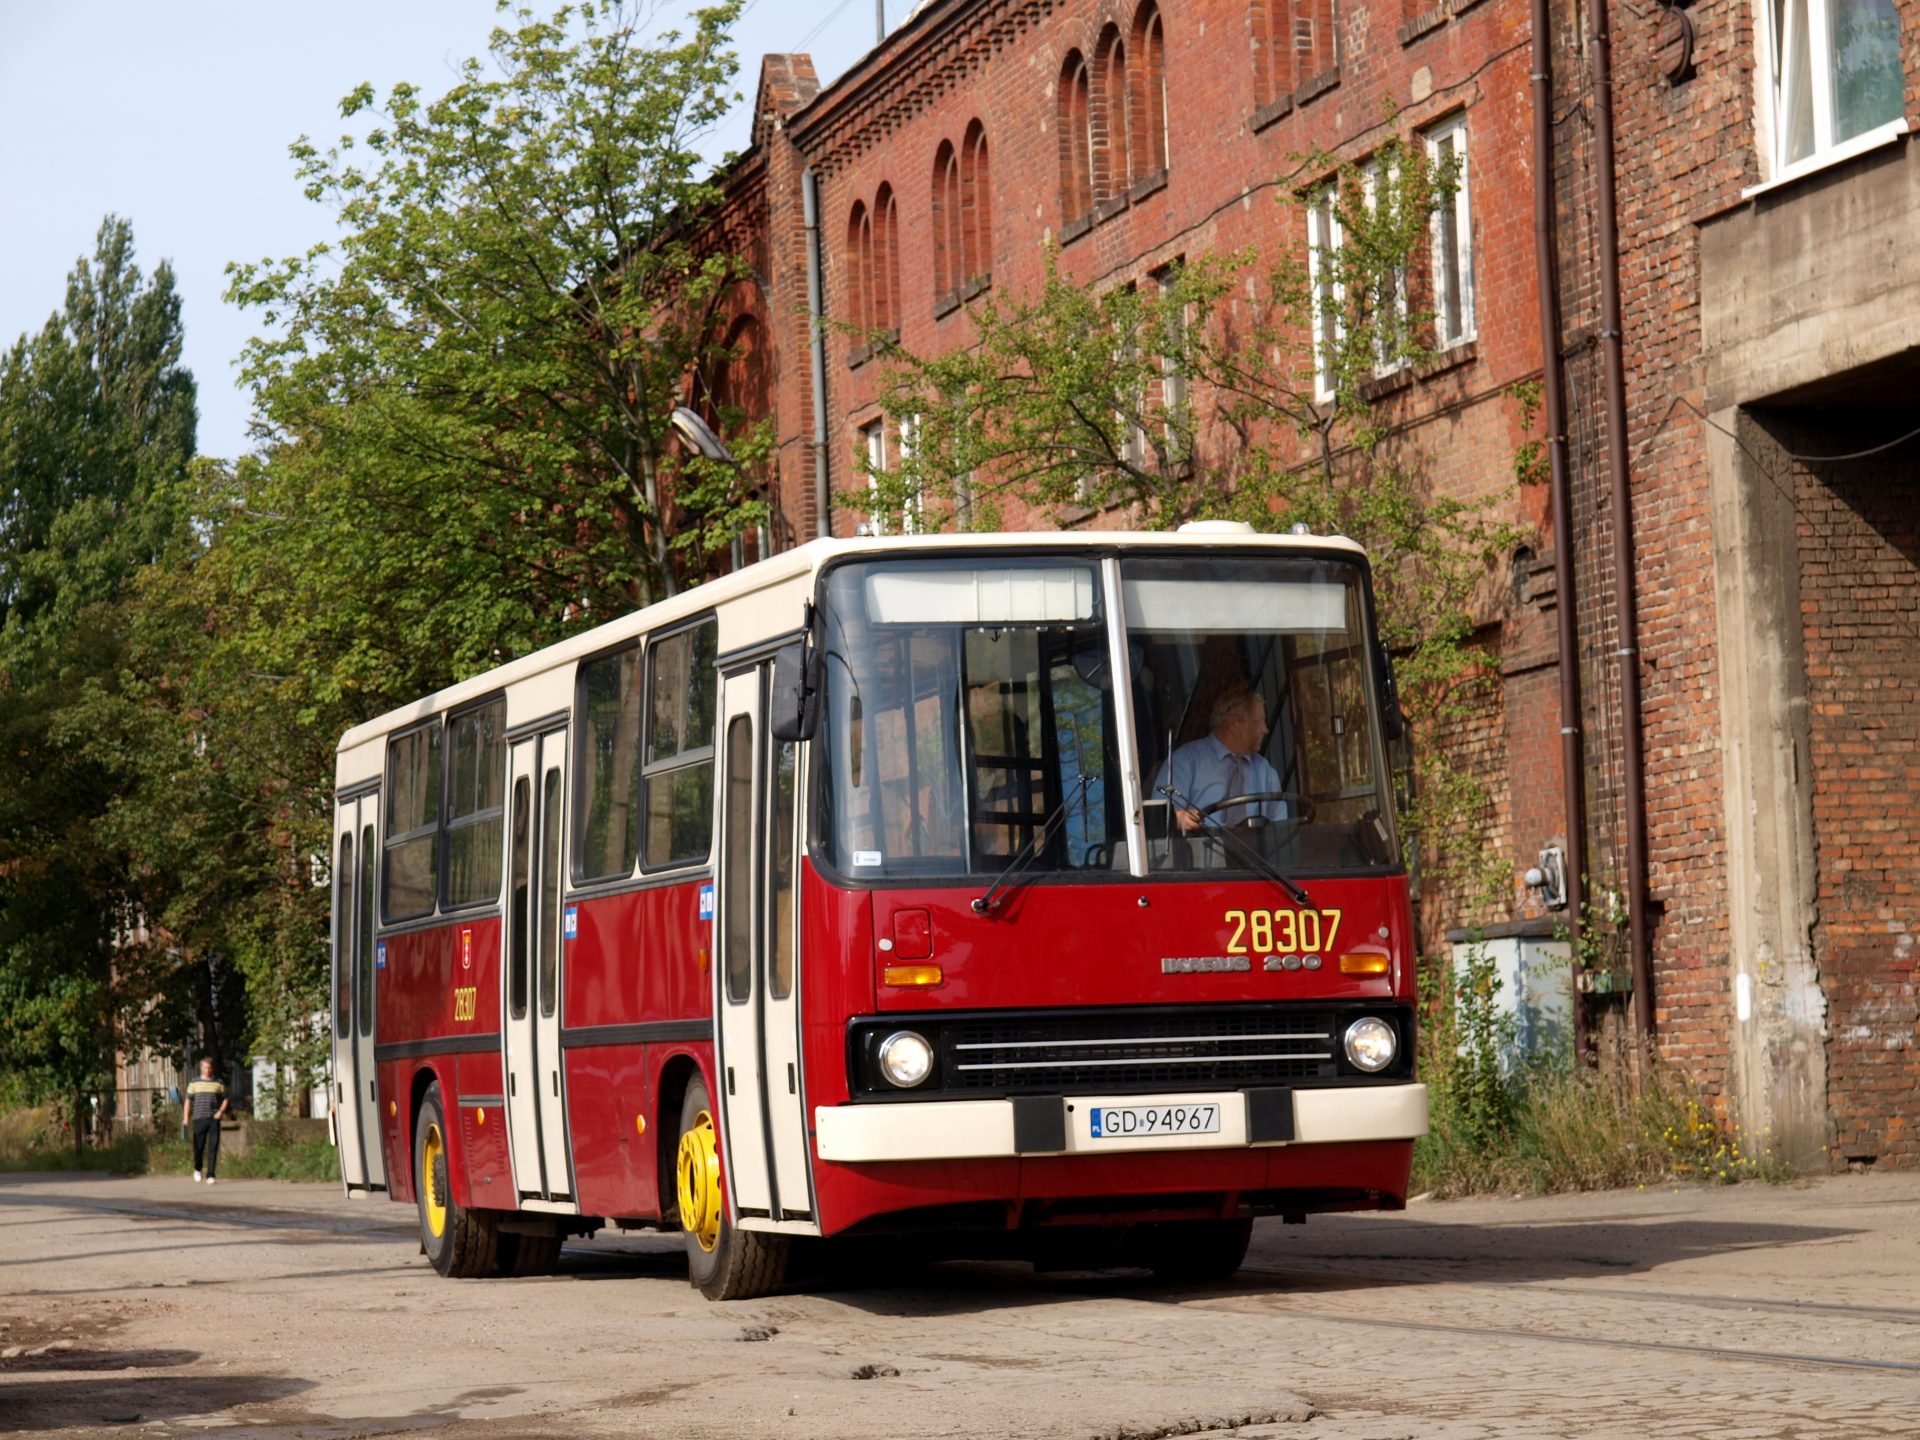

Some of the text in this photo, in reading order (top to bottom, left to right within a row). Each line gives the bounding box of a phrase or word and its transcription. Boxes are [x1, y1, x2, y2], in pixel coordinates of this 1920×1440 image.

[1225, 909, 1341, 953] 28307
[1161, 956, 1251, 974] IKARUS
[454, 986, 477, 1021] 28307
[1105, 1107, 1214, 1133] GD 94967
